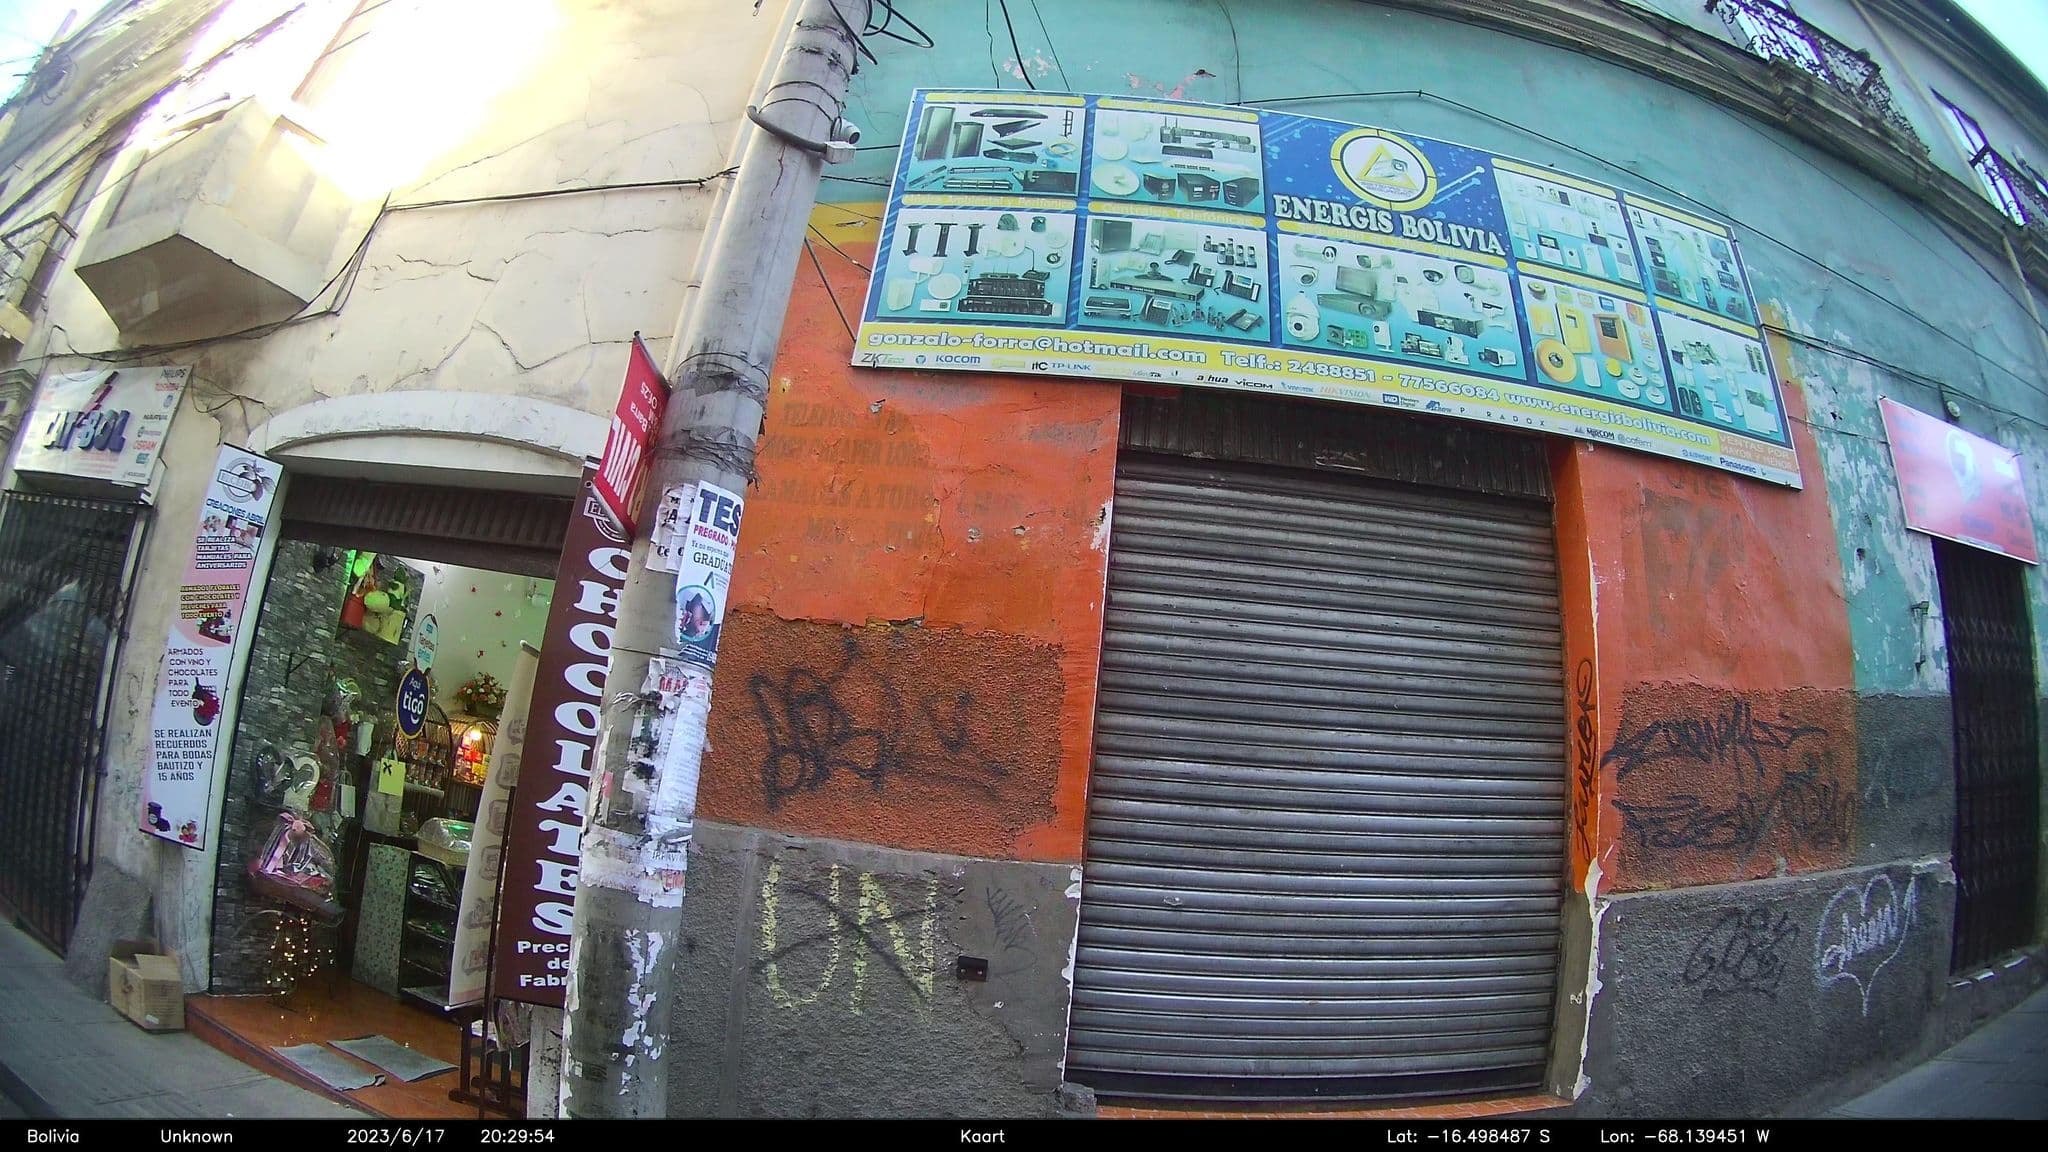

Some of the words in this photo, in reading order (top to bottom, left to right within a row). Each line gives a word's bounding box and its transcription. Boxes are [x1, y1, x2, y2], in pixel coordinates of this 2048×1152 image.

[1273, 194, 1394, 234] ENERGIS
[1400, 214, 1507, 256] BOLIVIA
[868, 332, 1207, 365] gonzalo-forra@hotmail.com
[1221, 351, 1281, 371] Telf.:
[1287, 360, 1376, 382] 2488851
[1398, 374, 1500, 402] 77566084
[1504, 393, 1712, 446] www.energisbolivia.com
[699, 489, 741, 537] TES
[171, 700, 199, 708] EVENTO
[154, 729, 165, 738] SE
[168, 729, 212, 738] REALIZAN
[155, 740, 208, 748] RECUERDOS
[156, 750, 180, 759] PARA
[183, 750, 213, 759] BODAS
[157, 761, 194, 770] BAUTIZO
[198, 761, 204, 770] Y
[158, 772, 168, 781] 15
[170, 771, 195, 781] AÑOS
[517, 941, 569, 953] Prec
[547, 957, 570, 969] de
